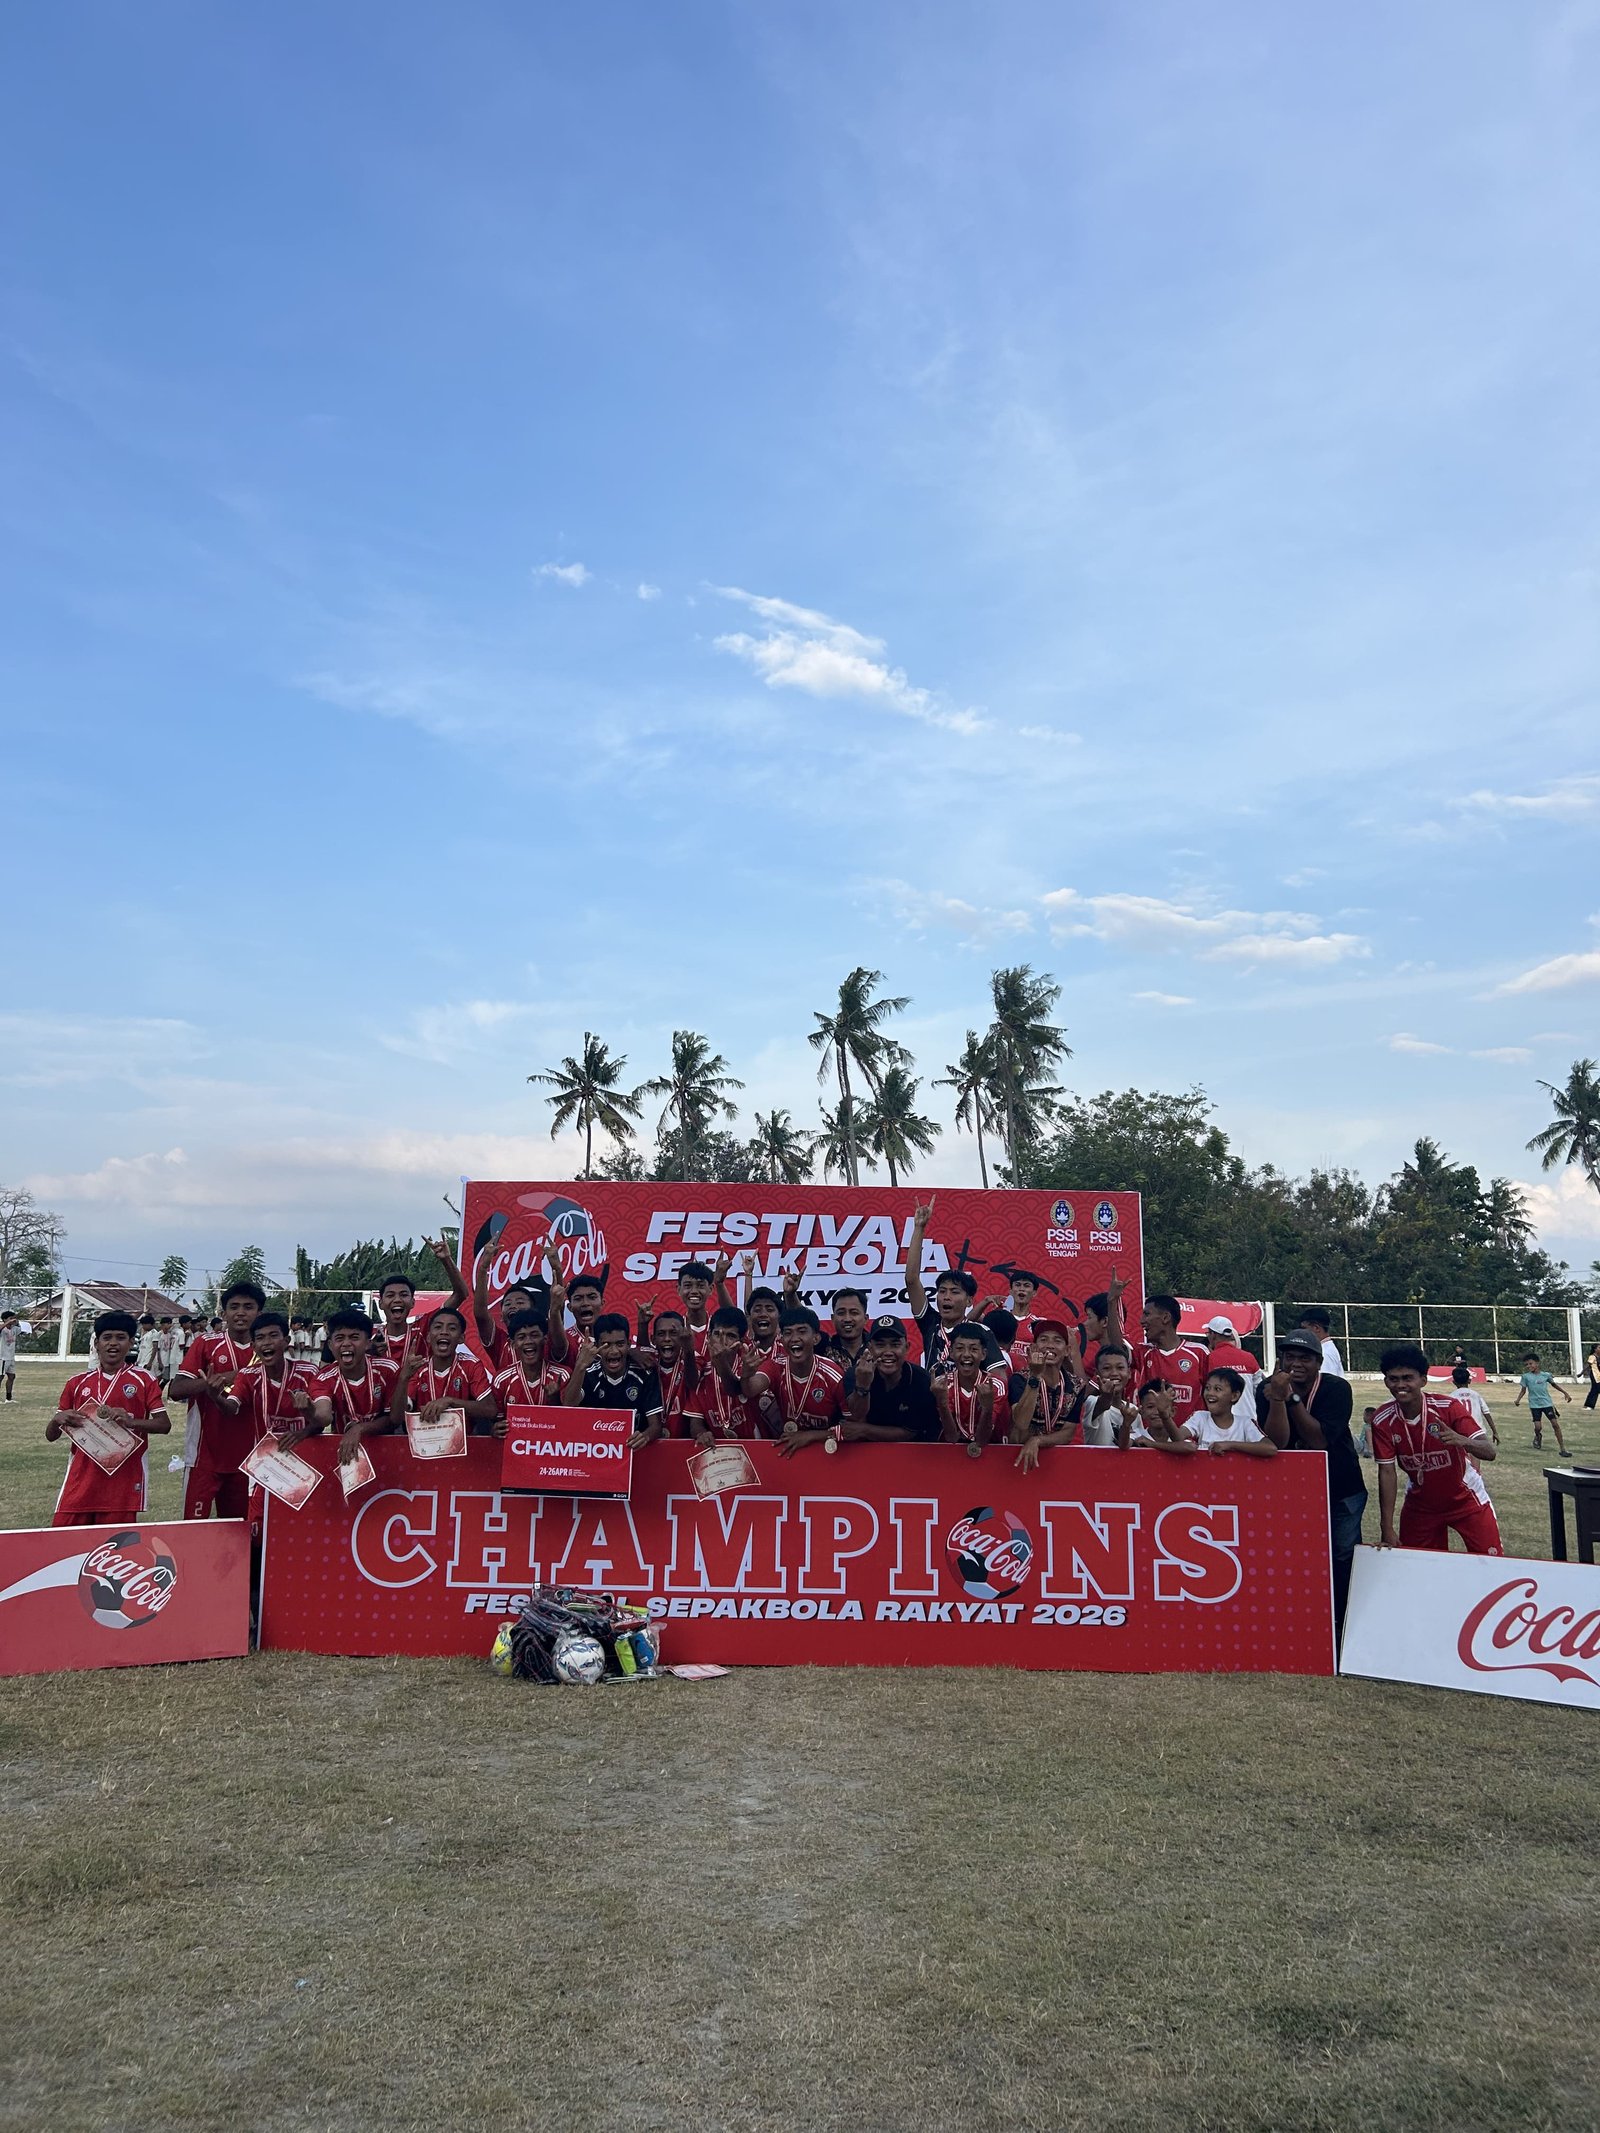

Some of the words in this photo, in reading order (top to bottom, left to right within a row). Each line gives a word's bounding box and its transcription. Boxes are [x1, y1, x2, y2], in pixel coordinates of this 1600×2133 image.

[1047, 1229, 1077, 1241] PSSI
[1090, 1231, 1121, 1244] PSSI
[1045, 1242, 1081, 1250] SULAWESI
[511, 1439, 623, 1459] CHAMPION
[82, 1542, 177, 1612] Coca-Cola
[647, 1597, 864, 1622] SEPAKBOLA
[875, 1601, 1024, 1625] RAKYAT
[1031, 1604, 1127, 1626] 2026
